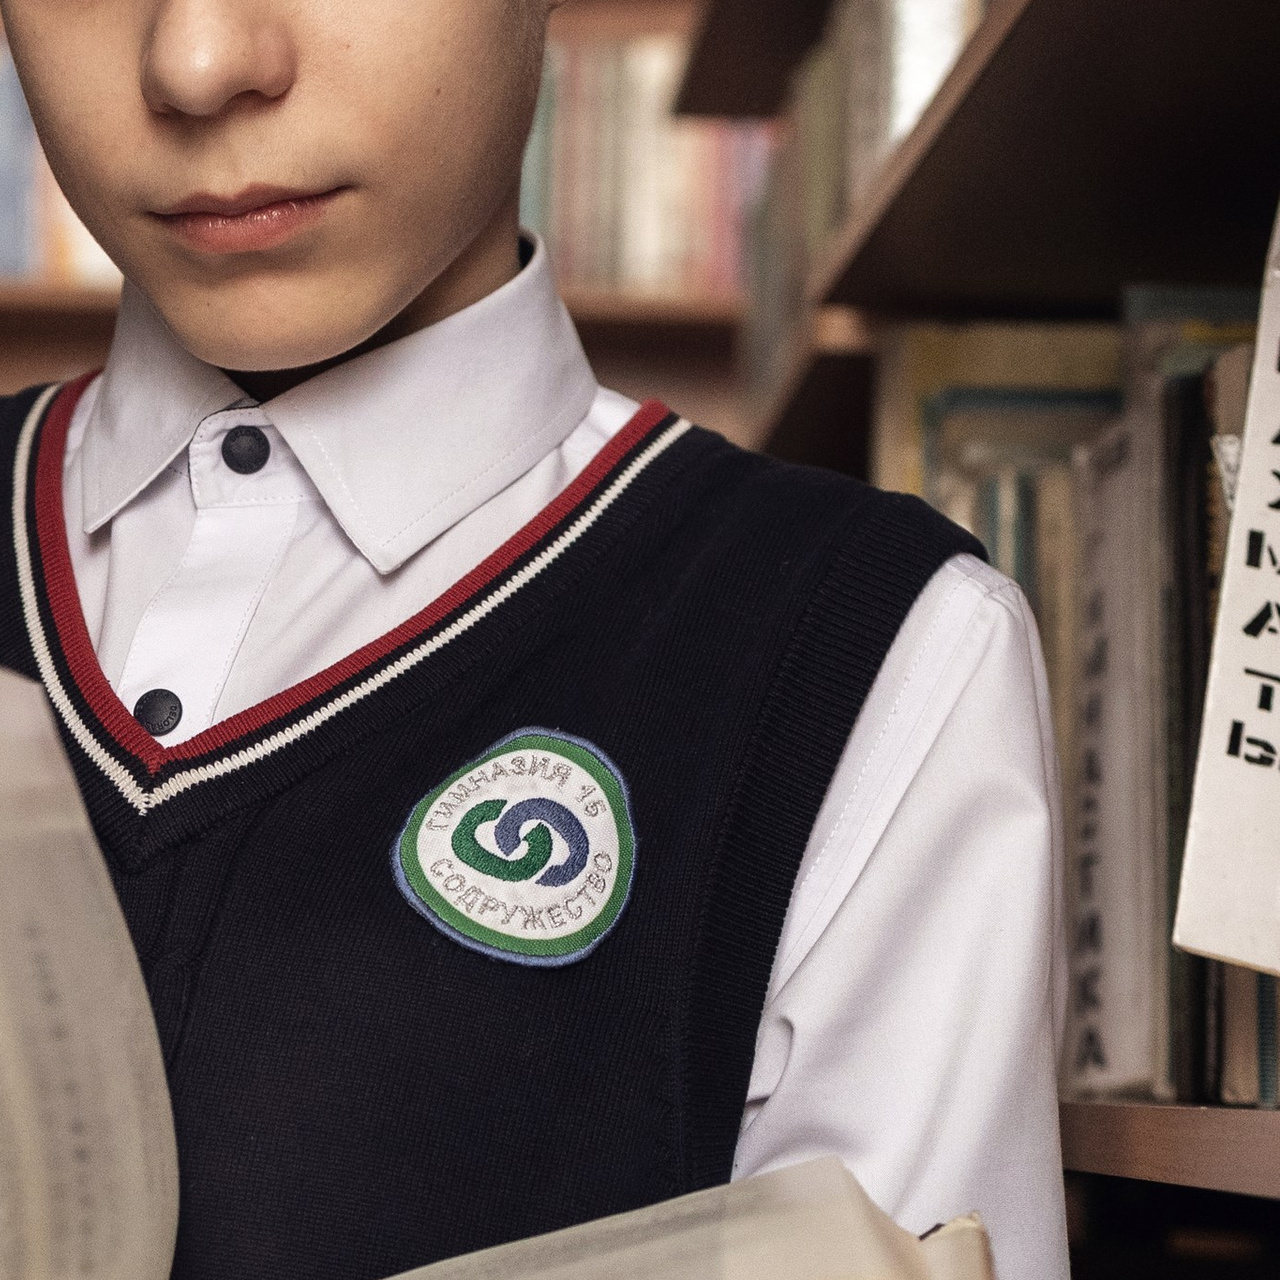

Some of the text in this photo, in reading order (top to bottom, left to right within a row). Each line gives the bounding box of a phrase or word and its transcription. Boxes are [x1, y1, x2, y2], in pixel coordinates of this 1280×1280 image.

[426, 755, 607, 832] ГИМНАЗИЯ 15
[430, 851, 613, 930] СОДРУЖЕСТВО
